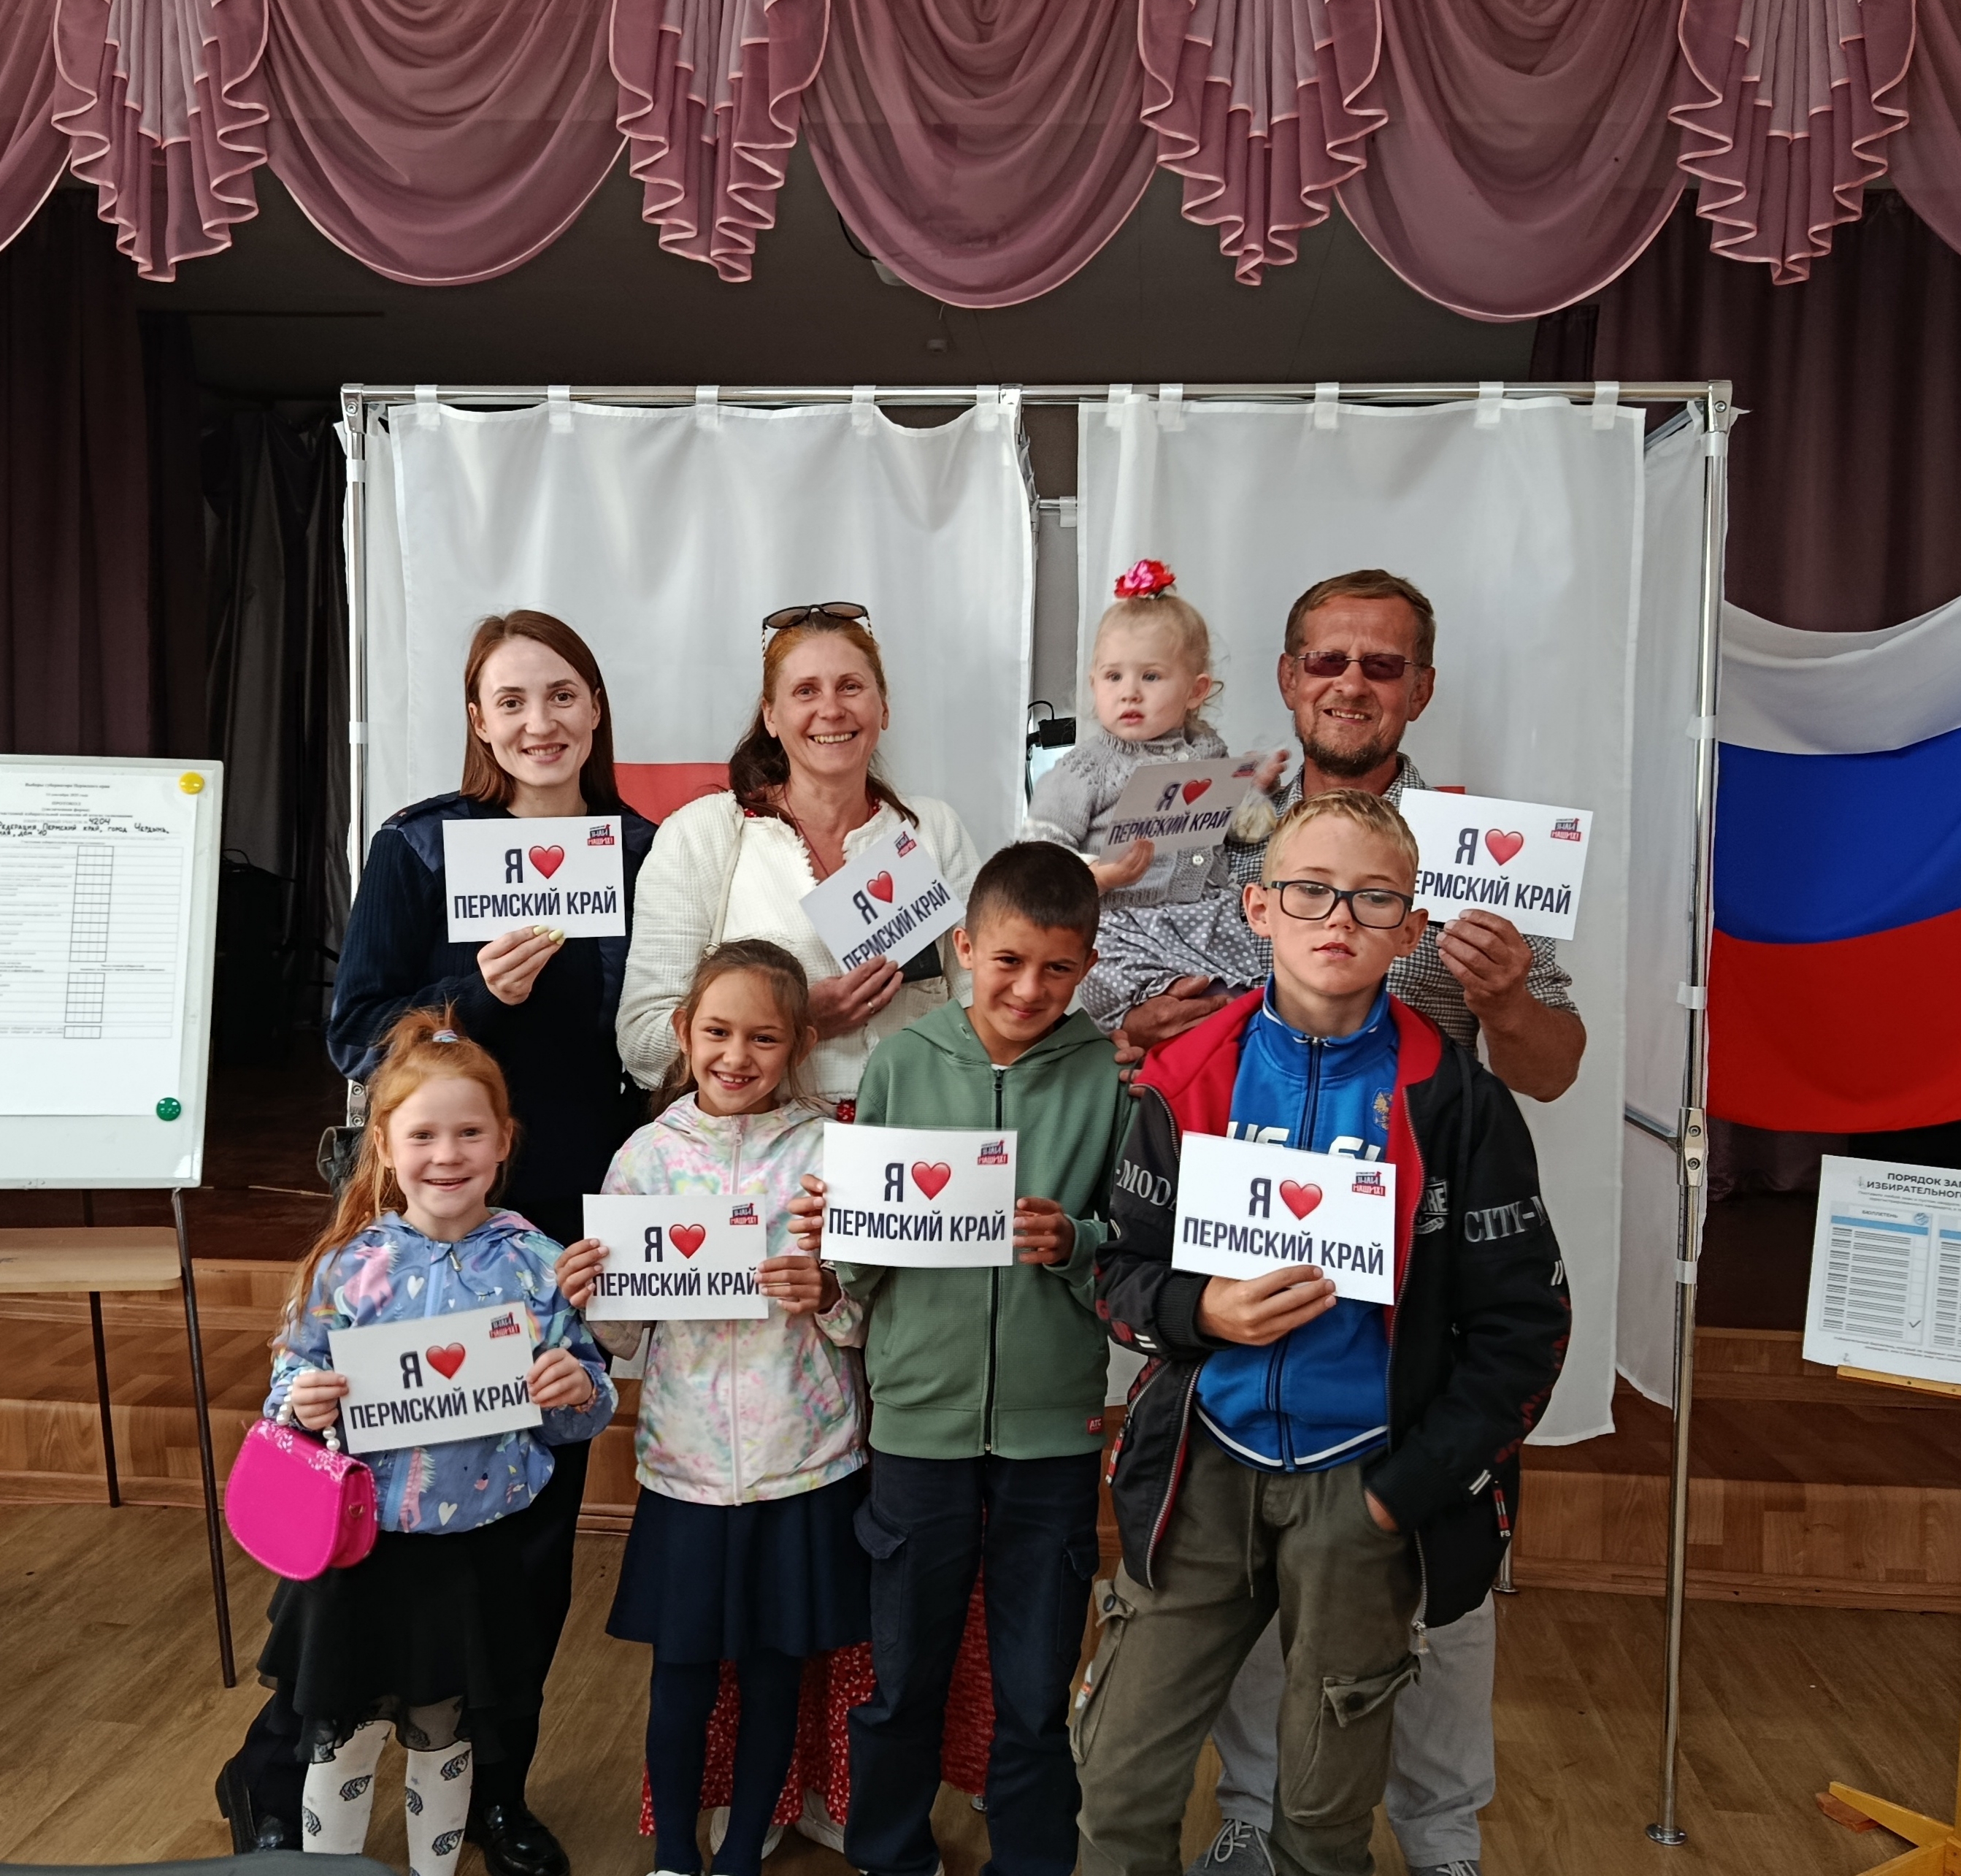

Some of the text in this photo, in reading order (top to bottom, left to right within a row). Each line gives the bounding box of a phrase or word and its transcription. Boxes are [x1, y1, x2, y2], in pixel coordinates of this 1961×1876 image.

[1155, 781, 1182, 811] Я
[1108, 806, 1234, 846] ПЕРМСКИЙ КРАЙ
[1455, 827, 1479, 865] Я
[505, 849, 523, 884] Я
[454, 886, 617, 919] ПЕРМСКИЙ КРАЙ
[853, 889, 879, 925] Я
[1414, 870, 1572, 915] ЕРМСКИЙ КРАЙ
[842, 879, 951, 972] ПЕРМСКИЙ КРАЙ
[884, 1163, 905, 1203] Я
[1248, 1177, 1272, 1218] Я
[1867, 1181, 1961, 1198] ИЗБИРАТЕЛЬНОГ
[1887, 1173, 1941, 1186] ПОРЯДОК
[829, 1208, 1005, 1241] ПЕРМСКИЙ КРАЙ
[645, 1226, 663, 1263] Я
[1183, 1216, 1384, 1276] ПЕРМСКИЙ КРАЙ
[593, 1267, 759, 1296] ПЕРМСКИЙ КРАЙ
[399, 1351, 423, 1389] Я
[349, 1375, 530, 1430] ПЕРМСКИЙ КРАЙ
